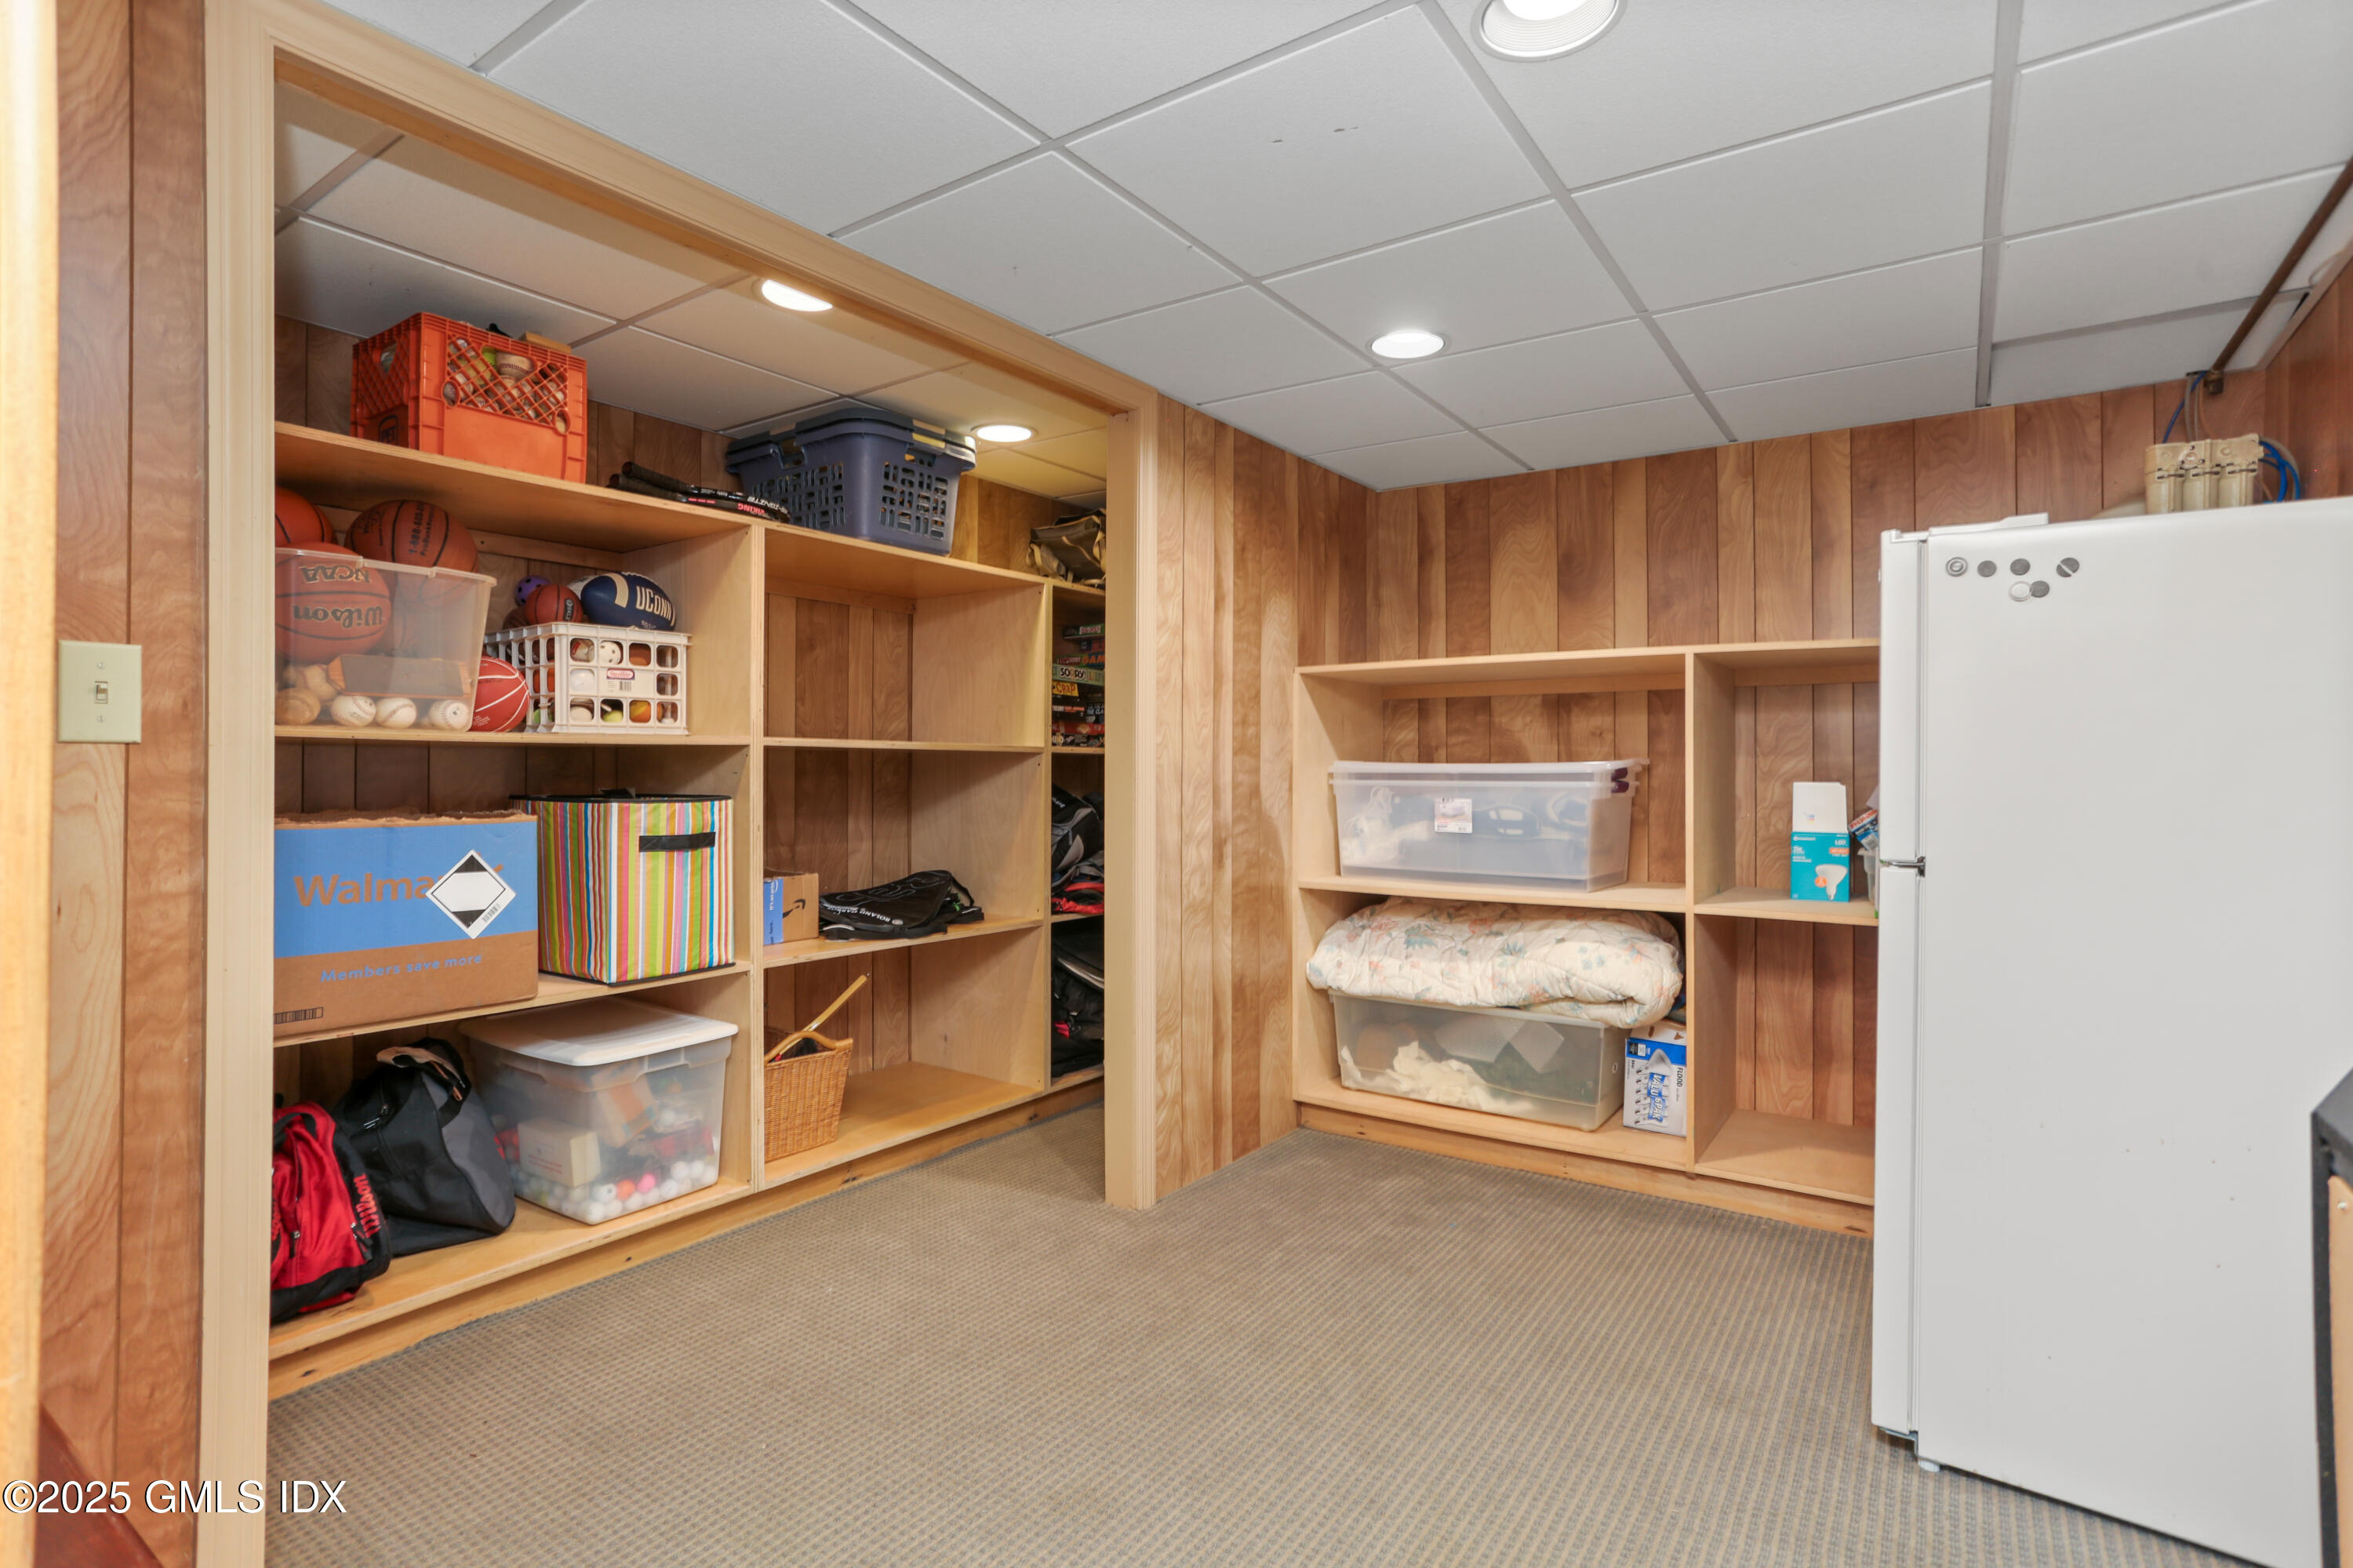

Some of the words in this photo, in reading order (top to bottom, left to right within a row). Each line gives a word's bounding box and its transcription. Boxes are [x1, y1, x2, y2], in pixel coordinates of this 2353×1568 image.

[737, 503, 766, 515] VIKING
[300, 564, 371, 584] NCAA
[635, 585, 672, 621] UCONN
[292, 604, 384, 628] Wilson
[859, 908, 890, 922] ROLAND
[319, 965, 400, 982] Members
[406, 959, 440, 973] save
[444, 954, 482, 968] more
[1650, 1074, 1663, 1096] VALU
